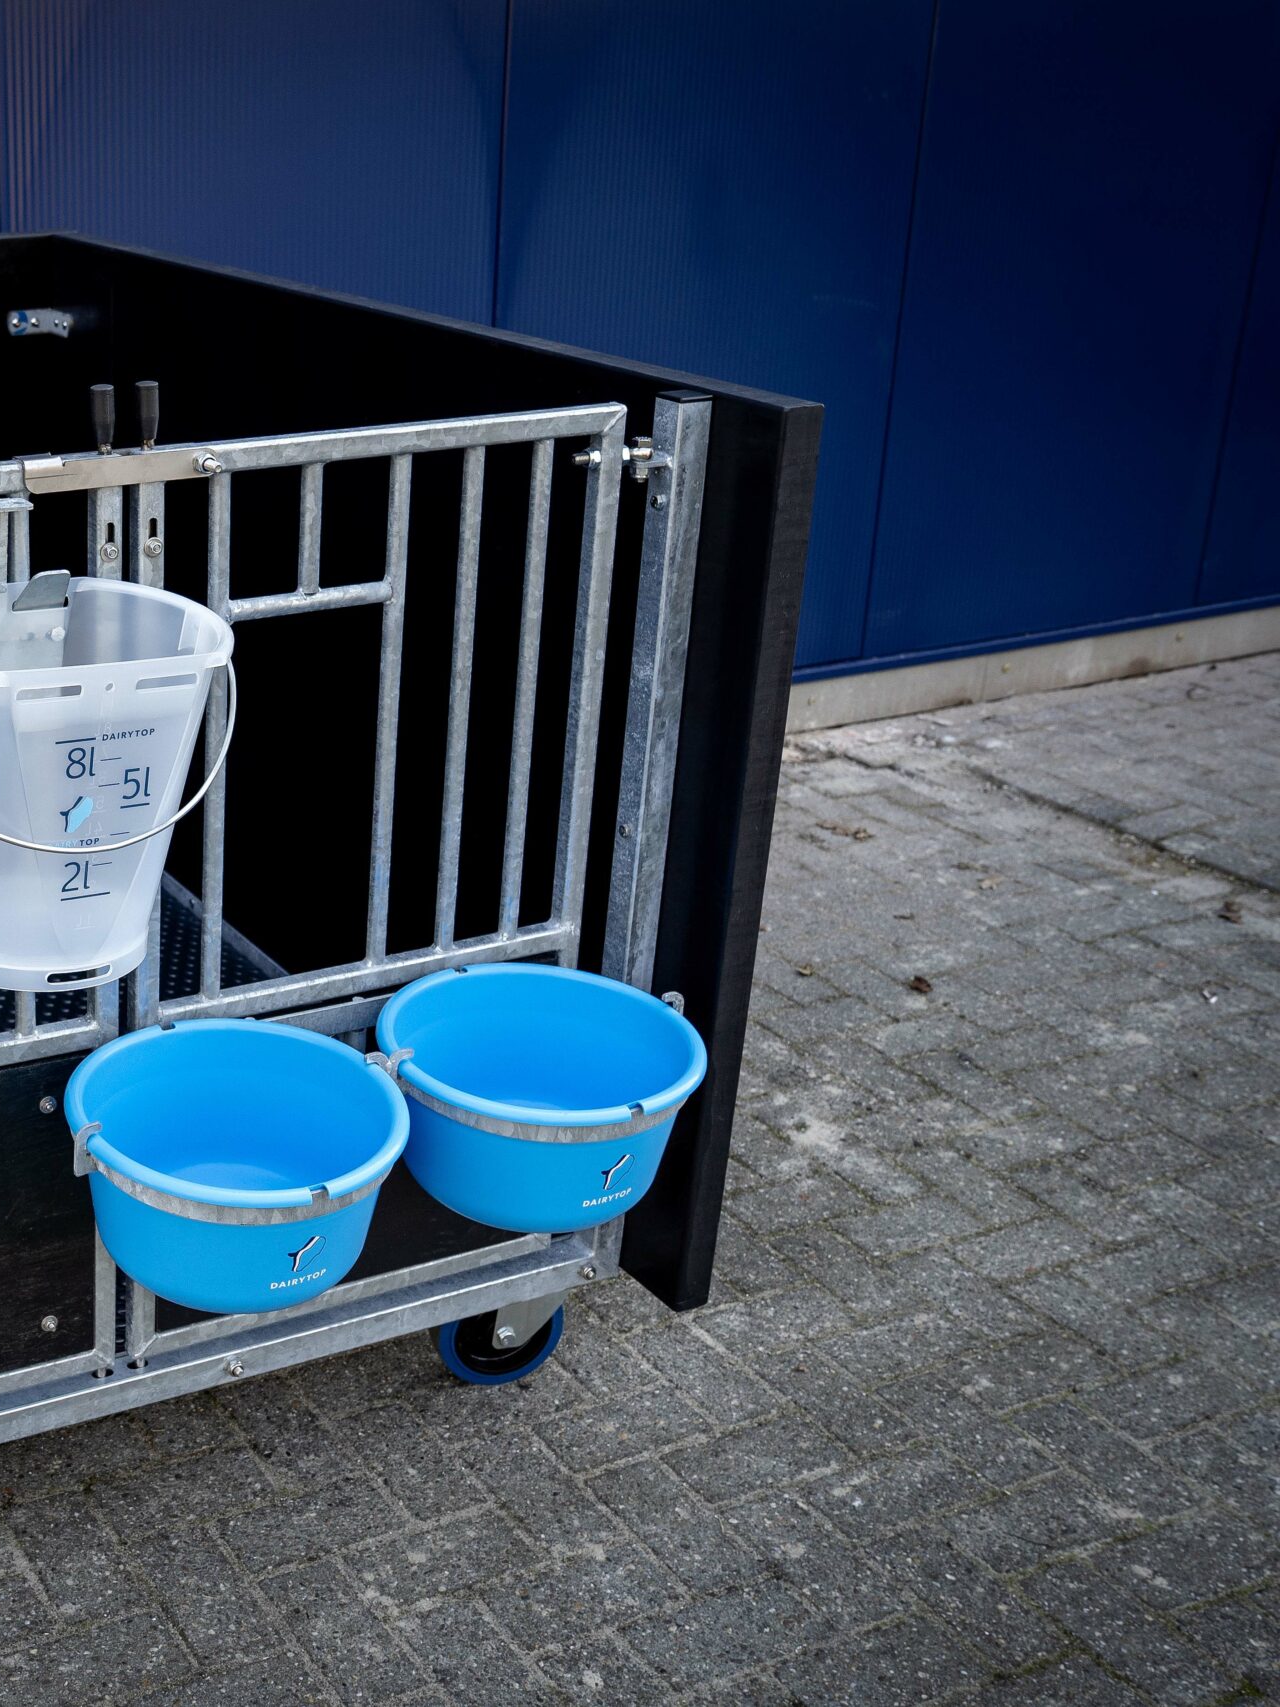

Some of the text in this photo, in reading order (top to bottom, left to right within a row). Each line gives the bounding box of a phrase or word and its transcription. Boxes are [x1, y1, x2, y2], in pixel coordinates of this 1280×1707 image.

[102, 728, 156, 741] DAIRYTOP
[65, 746, 96, 779] 8l
[122, 766, 151, 800] 5l
[61, 860, 91, 893] 2l
[582, 1187, 632, 1208] DAIRYTOP
[270, 1268, 327, 1290] DAIRYTOP
